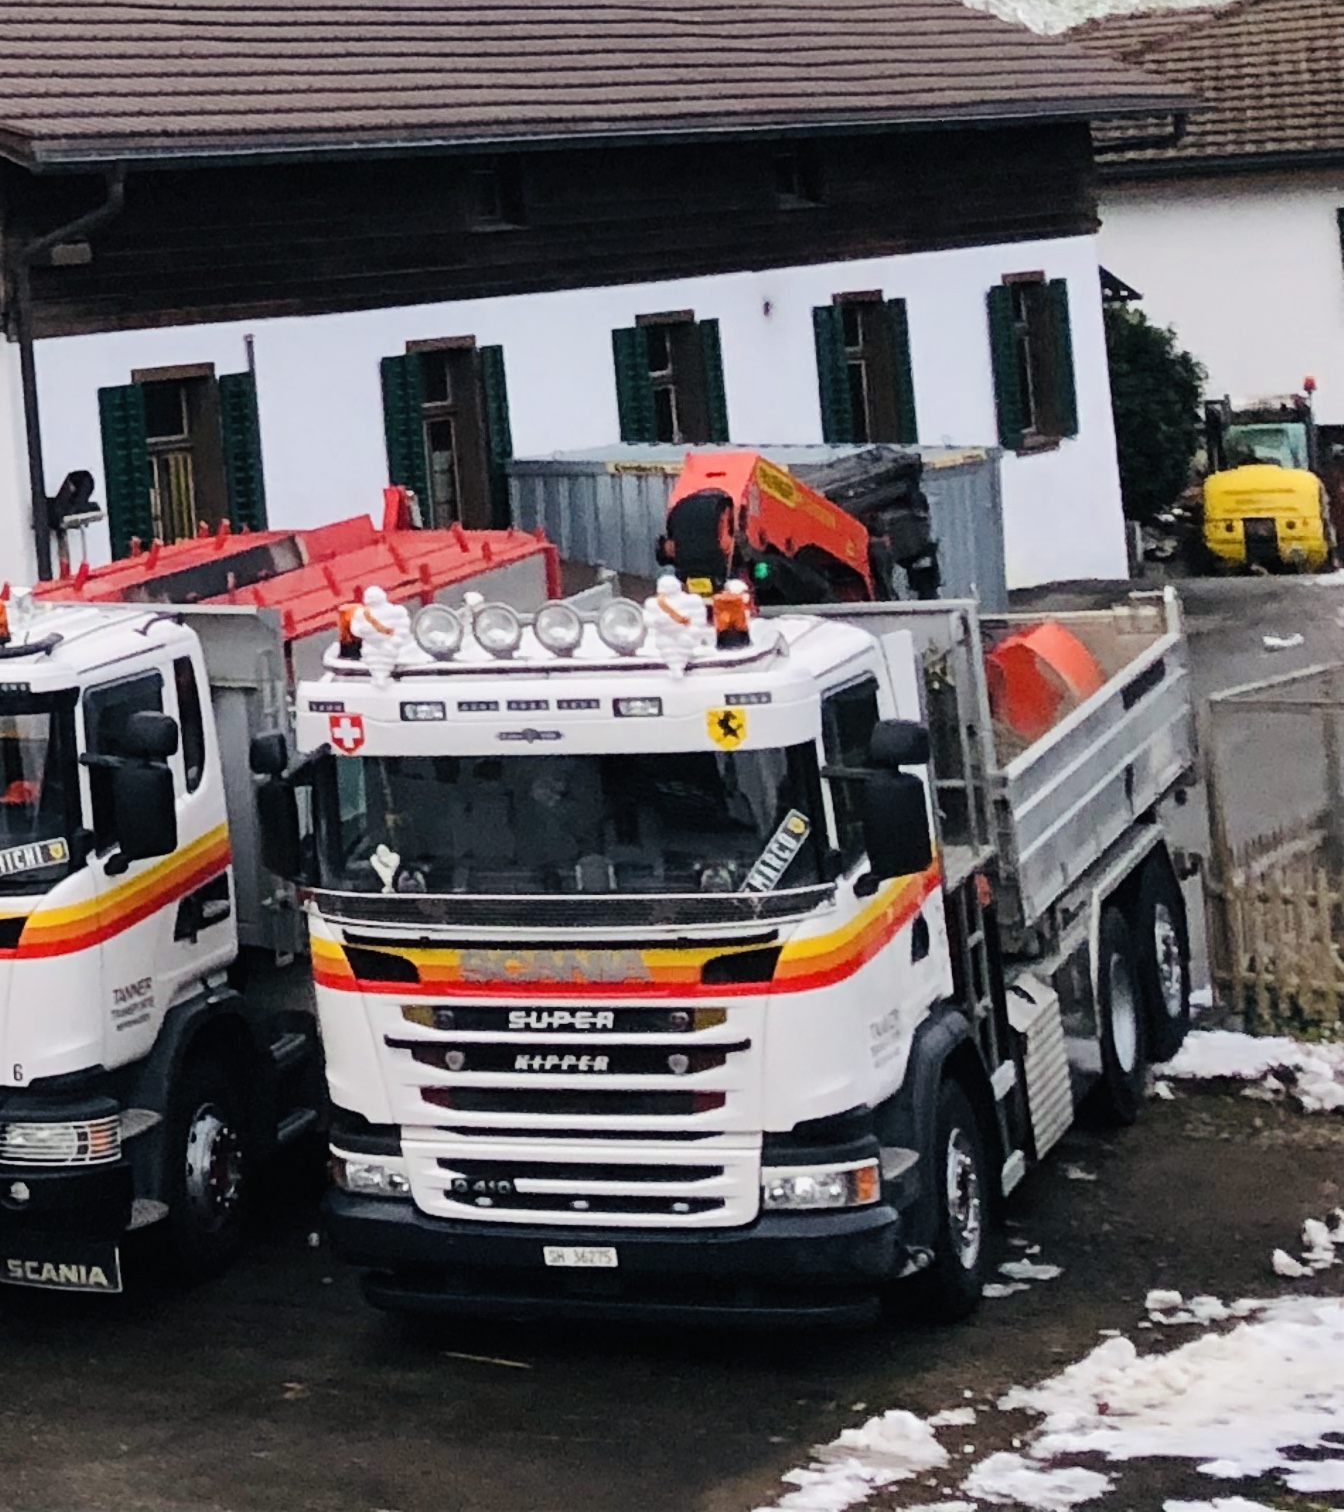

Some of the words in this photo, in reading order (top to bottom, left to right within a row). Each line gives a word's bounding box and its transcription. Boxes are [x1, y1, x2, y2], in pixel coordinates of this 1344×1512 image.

[748, 832, 799, 893] MARCO
[461, 950, 651, 983] SCANIA
[112, 976, 152, 1004] TANNER
[508, 1010, 616, 1029] SUPER
[13, 1063, 23, 1082] 6
[514, 1053, 610, 1072] KIPPER
[6, 1258, 109, 1287] SCANIA
